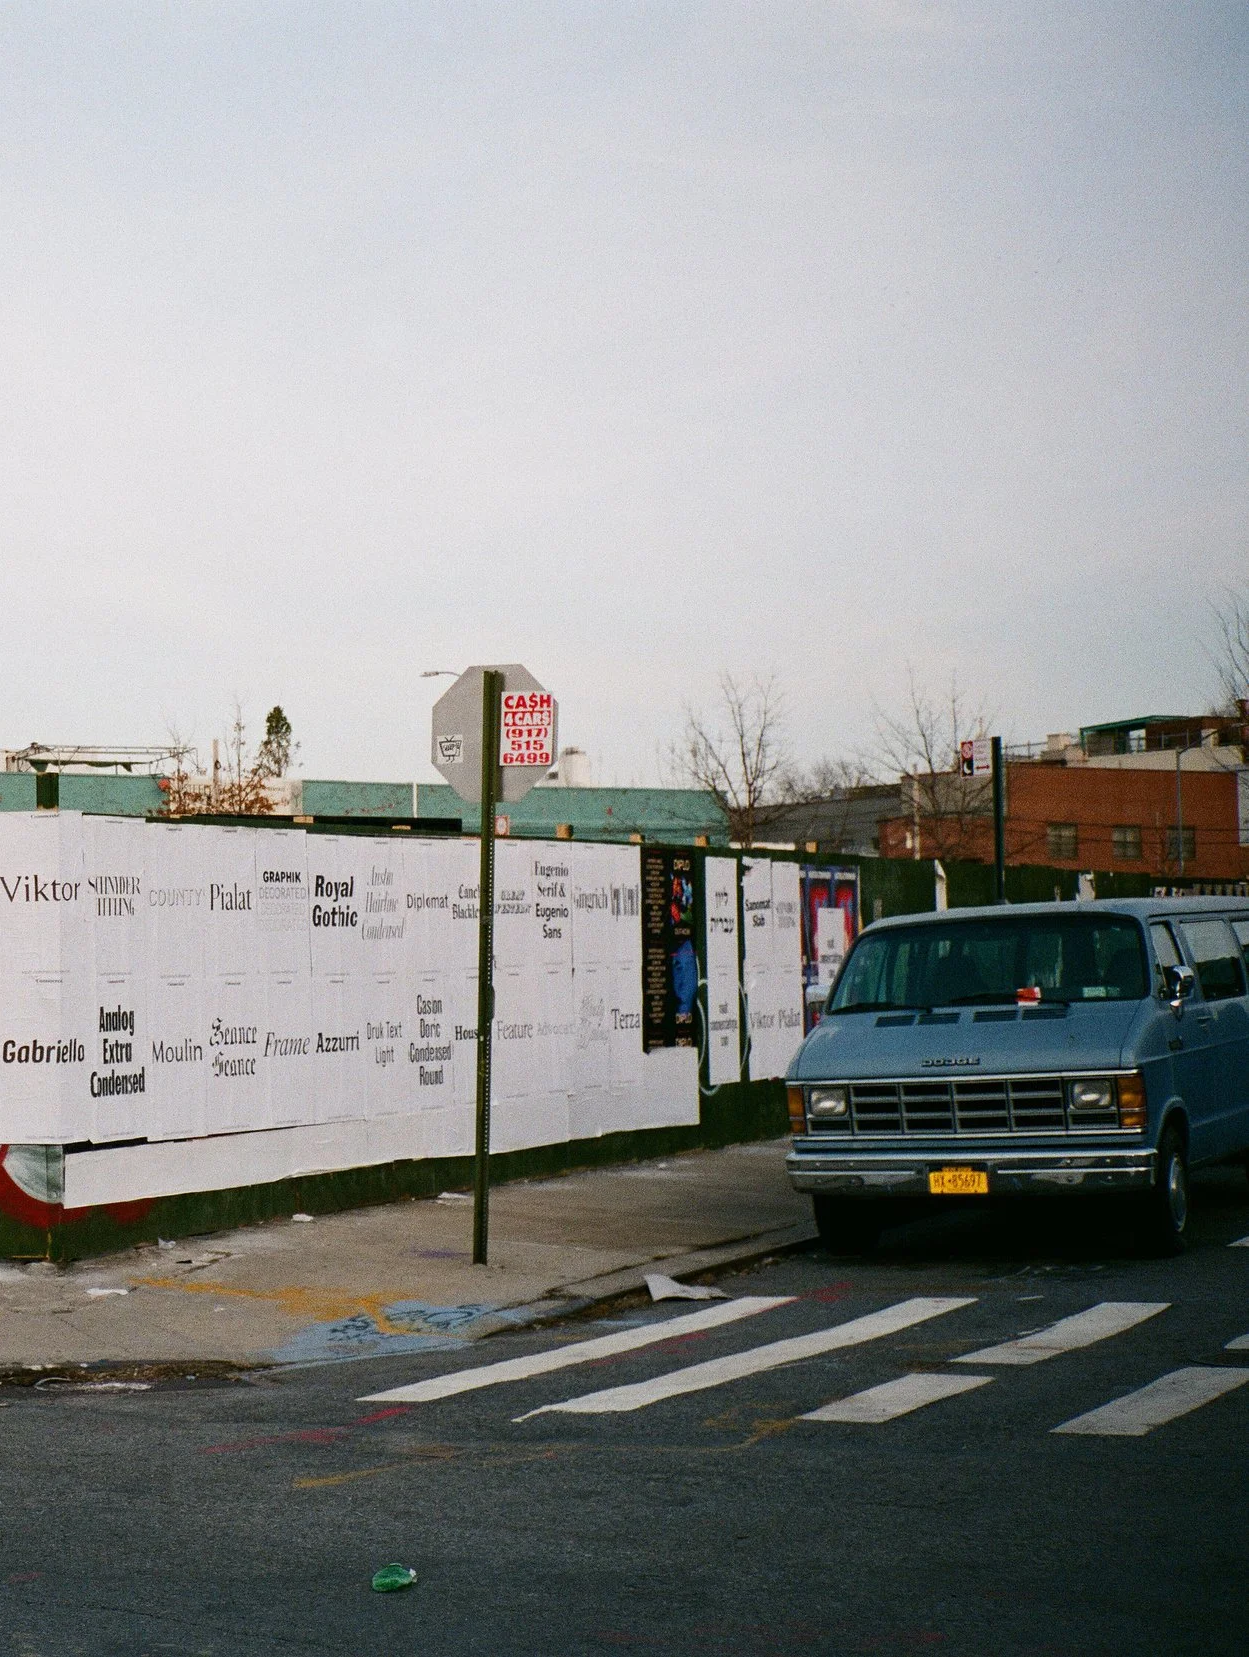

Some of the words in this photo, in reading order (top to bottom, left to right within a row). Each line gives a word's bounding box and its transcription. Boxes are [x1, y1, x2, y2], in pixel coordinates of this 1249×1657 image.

[504, 693, 551, 710] CA$H
[506, 728, 548, 739] (917)
[511, 740, 544, 751] 515
[503, 752, 550, 764] 6499
[263, 871, 302, 883] GRAPHIK
[534, 861, 568, 881] Eugenio
[0, 875, 81, 903] Viktor
[149, 888, 202, 906] COUNTY
[210, 882, 252, 910] Pialat
[259, 887, 307, 900] DECORATED
[315, 875, 354, 902] Royal
[458, 884, 480, 899] Canel
[537, 882, 557, 898] Serif
[559, 884, 566, 898] &
[407, 893, 448, 911] Diplomat
[536, 902, 568, 921] Eugenio
[312, 904, 358, 928] Gothic
[542, 924, 562, 938] Sans
[99, 1005, 134, 1036] Analog
[420, 1018, 440, 1038] Doric
[612, 1009, 640, 1030] Terza
[209, 1017, 258, 1046] Seance
[366, 1022, 384, 1040] Druk
[386, 1021, 402, 1038] Text
[454, 1026, 478, 1040] Hous
[497, 1021, 534, 1040] Feature
[2, 1038, 85, 1064] Gabriello
[102, 1038, 132, 1064] Extra
[152, 1038, 203, 1064] Moulin
[263, 1032, 310, 1058] Frame
[316, 1030, 360, 1053] Azzurri
[410, 1041, 451, 1062] Condensed
[376, 1046, 394, 1068] Light
[922, 1056, 980, 1068] DODGE
[90, 1066, 146, 1098] Condensed
[420, 1065, 444, 1086] Round
